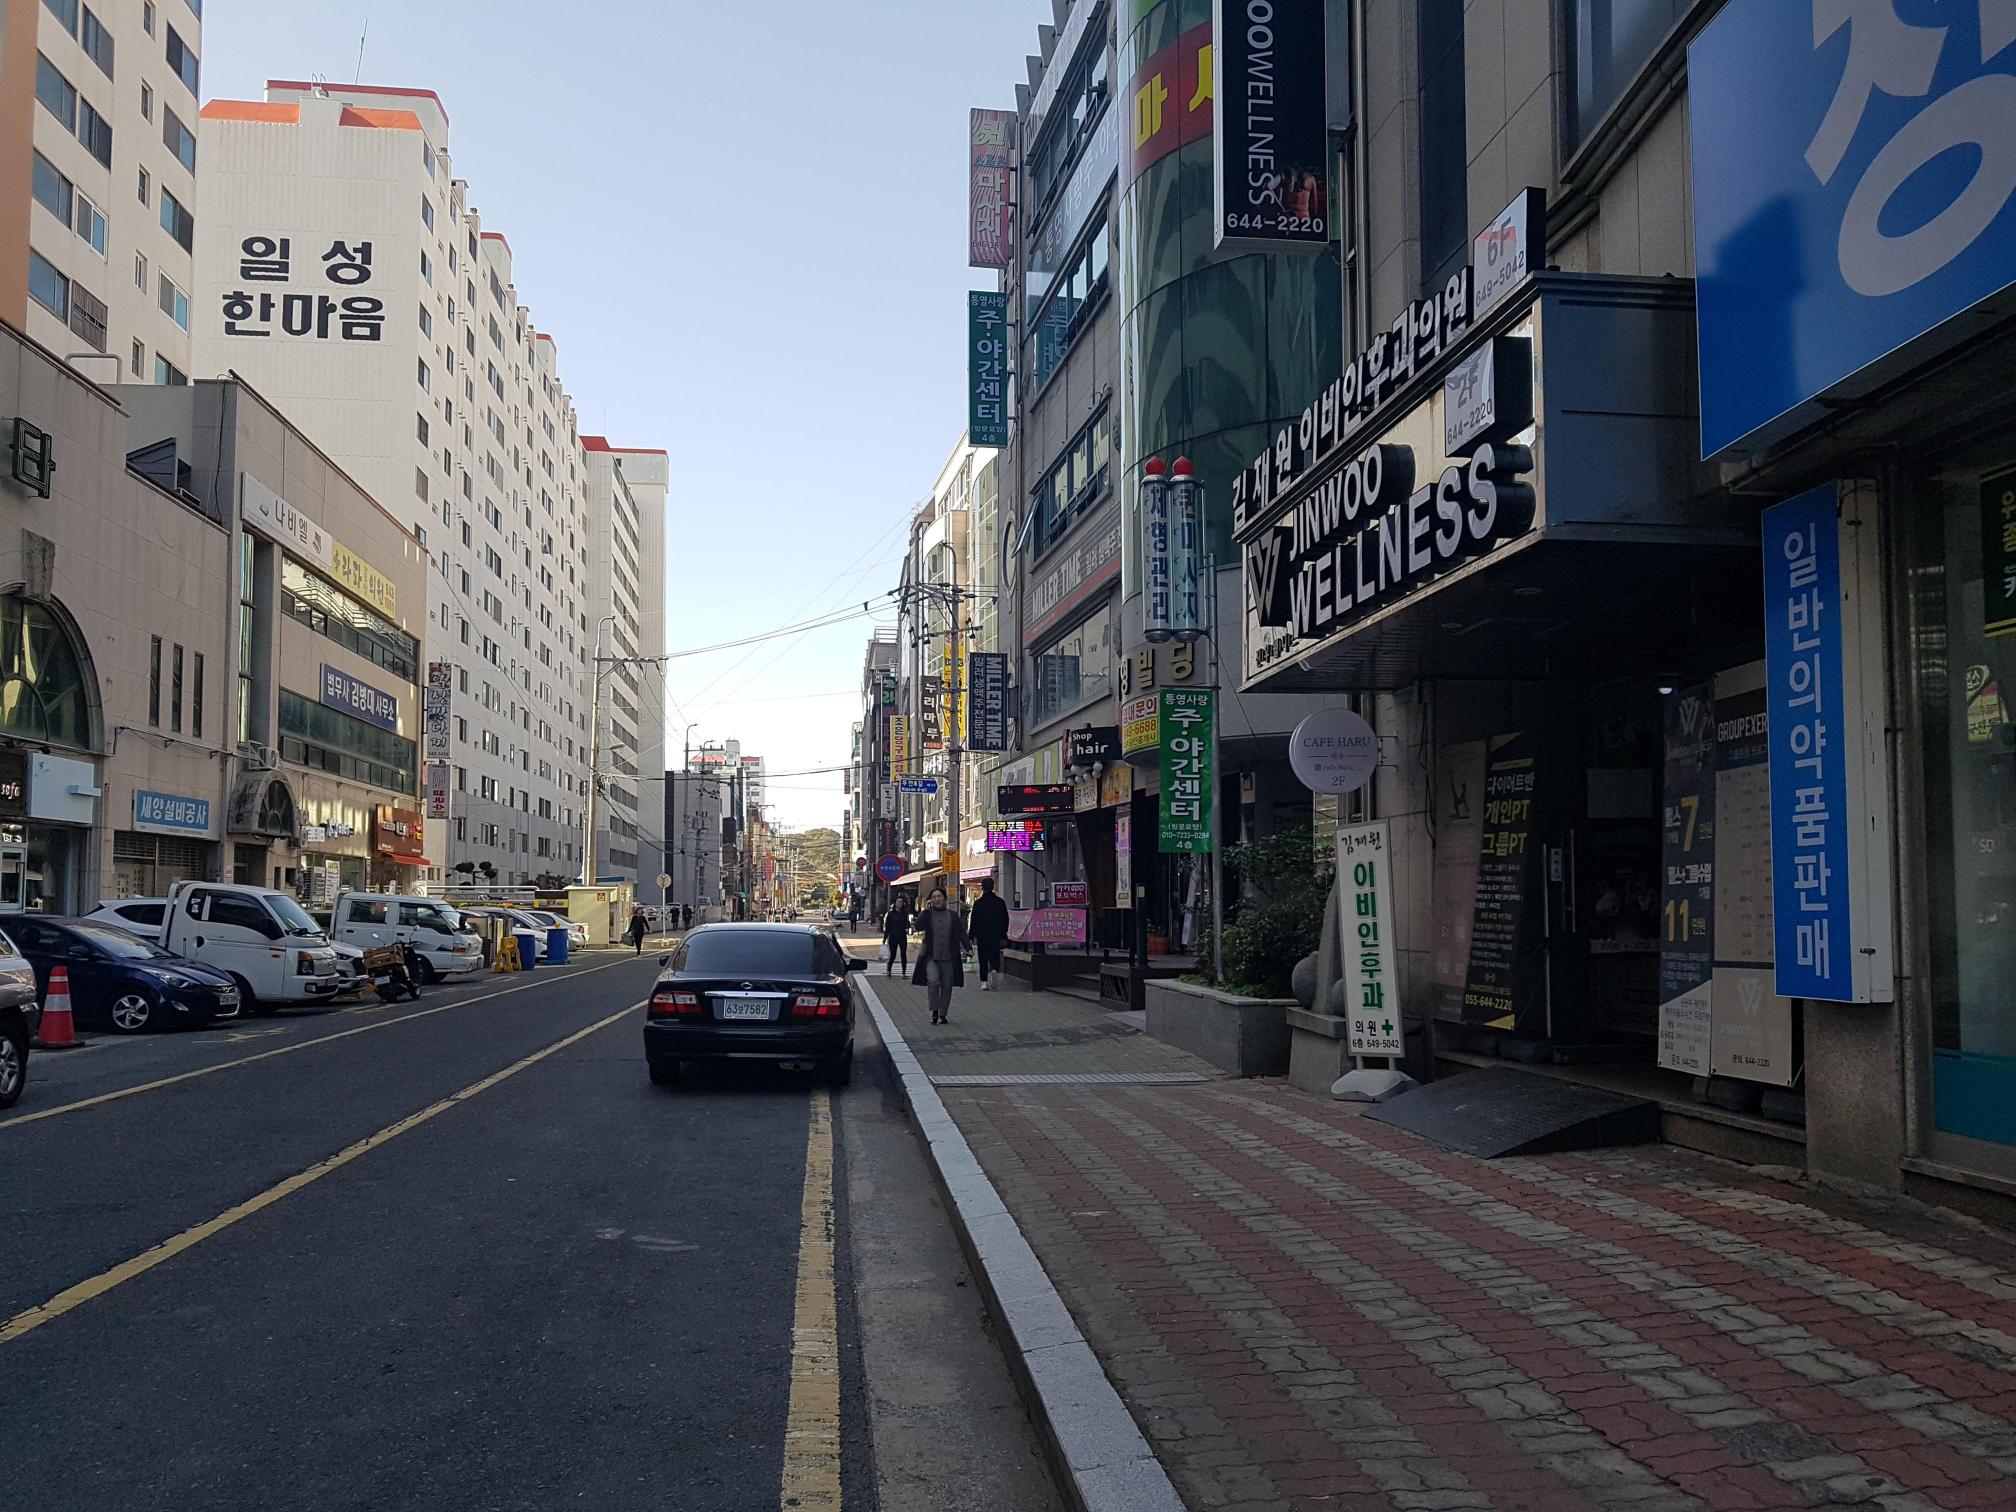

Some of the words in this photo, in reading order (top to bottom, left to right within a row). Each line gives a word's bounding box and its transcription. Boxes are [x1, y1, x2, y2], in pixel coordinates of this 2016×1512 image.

[977, 172, 1006, 237] 마사지
[1226, 211, 1323, 234] 644-2220
[1487, 215, 1512, 267] 6F
[240, 235, 373, 286] 일성
[1475, 251, 1525, 308] 649-5042
[221, 290, 386, 341] 한마음
[971, 294, 1006, 308] 통영사랑
[1447, 399, 1493, 446] 644-2220
[1289, 443, 1383, 562] JINWOO
[275, 499, 308, 545] 나비엘
[1150, 486, 1169, 624] 체형관리
[1289, 442, 1497, 639] WELLNESS
[1032, 571, 1059, 623] MILLER
[1060, 547, 1082, 598] TIME
[327, 672, 350, 703] 법무사
[351, 681, 375, 716] 김병대
[376, 695, 395, 722] 사무소
[986, 657, 1003, 710] MILLER
[1165, 693, 1208, 706] 통영사랑
[986, 712, 1003, 747] TIME
[1072, 733, 1092, 741] Shop
[1303, 737, 1333, 748] CAFE
[1338, 736, 1370, 747] HARU
[1718, 718, 1745, 742] GROUP
[1076, 742, 1109, 755] hair
[1783, 522, 1831, 980] 일반의약품판매
[1332, 776, 1346, 786] 2F
[1487, 771, 1536, 796] 다이어트반
[141, 796, 208, 825] 세양설비공사
[1485, 799, 1531, 825] 개인PT
[1681, 795, 1699, 852] 7
[1341, 831, 1383, 856] 김재원
[1480, 831, 1528, 857] 그룹PT
[1353, 861, 1385, 1010] 이비인후과
[1665, 899, 1689, 942] 11
[1465, 994, 1513, 1011] 055-644-2220
[1352, 1037, 1364, 1049] 6층
[1366, 1039, 1400, 1049] 649-5042
[1355, 1020, 1377, 1037] 의원
[1744, 1056, 1770, 1067] 644-2220
